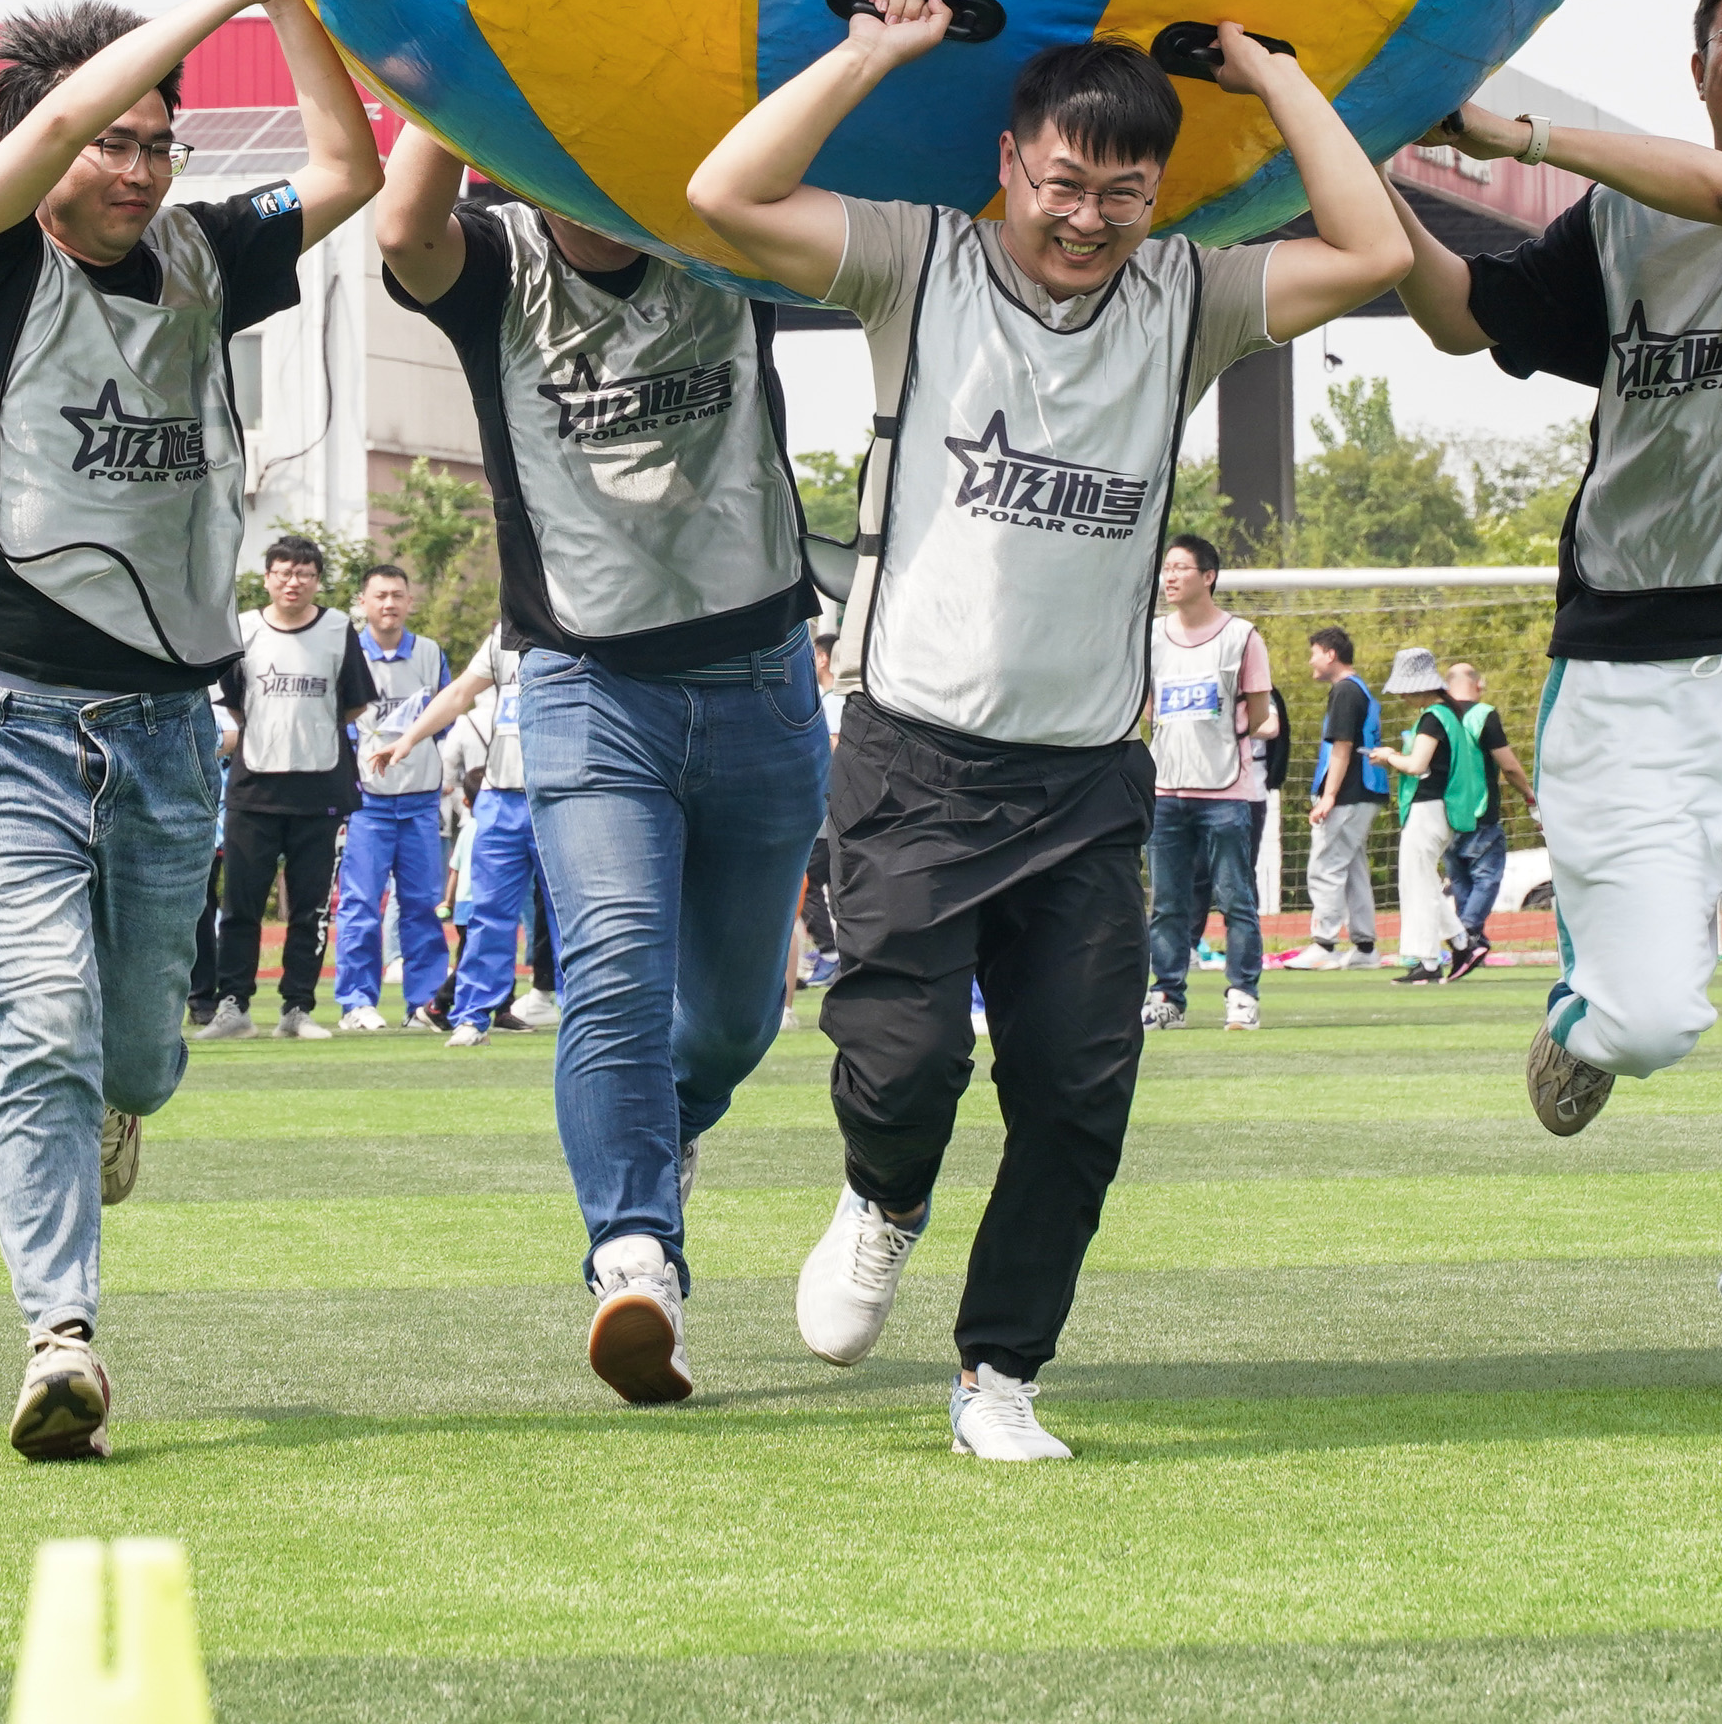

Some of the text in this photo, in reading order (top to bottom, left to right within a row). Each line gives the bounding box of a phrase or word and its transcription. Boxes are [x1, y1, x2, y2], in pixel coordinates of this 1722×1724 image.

[570, 360, 732, 430] 极地营
[1624, 382, 1695, 402] POLAR
[575, 401, 732, 443] POLAR CAMP
[89, 469, 170, 482] POLAR
[981, 459, 1148, 526] 极地营
[970, 506, 1134, 540] POLAR CAMP
[1167, 686, 1207, 709] 419
